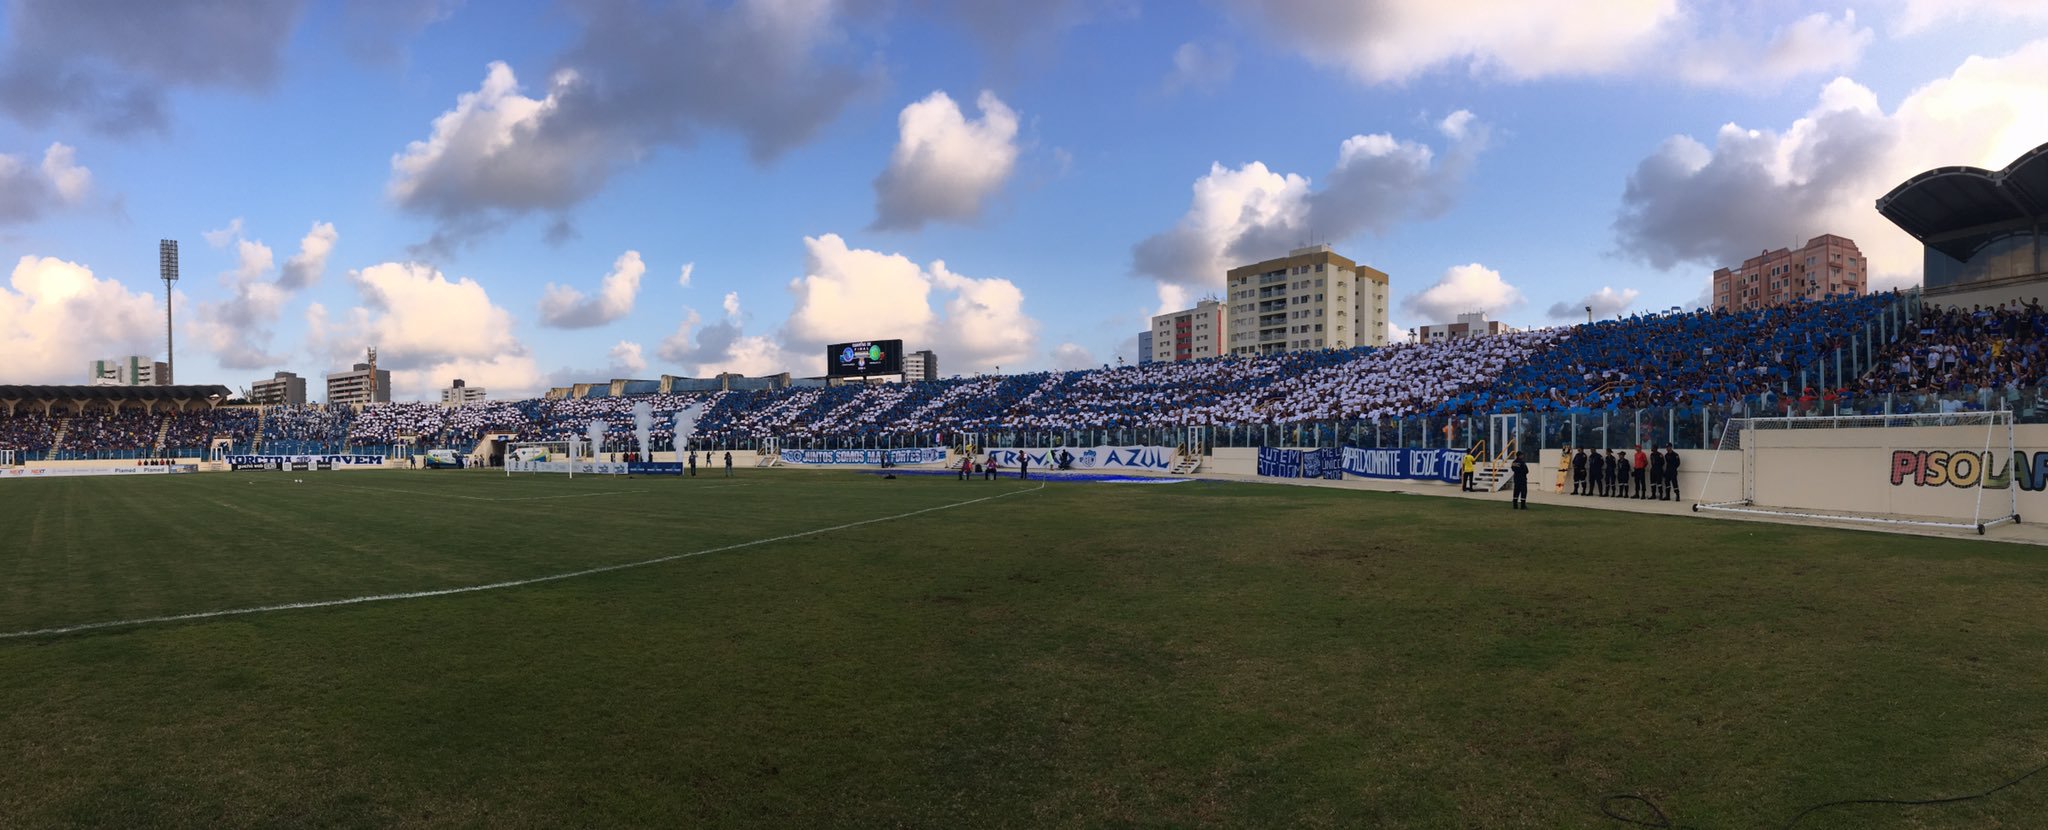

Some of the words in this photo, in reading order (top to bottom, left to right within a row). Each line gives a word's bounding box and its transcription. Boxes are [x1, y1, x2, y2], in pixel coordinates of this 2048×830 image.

[316, 455, 382, 464] JOVEM
[803, 451, 833, 462] JUNTOS
[836, 451, 864, 462] SOMOS
[867, 451, 888, 462] MAS
[891, 450, 921, 462] FORTES
[1104, 449, 1170, 468] AZUL
[1409, 450, 1440, 475] DESDE
[1441, 451, 1464, 480] 193
